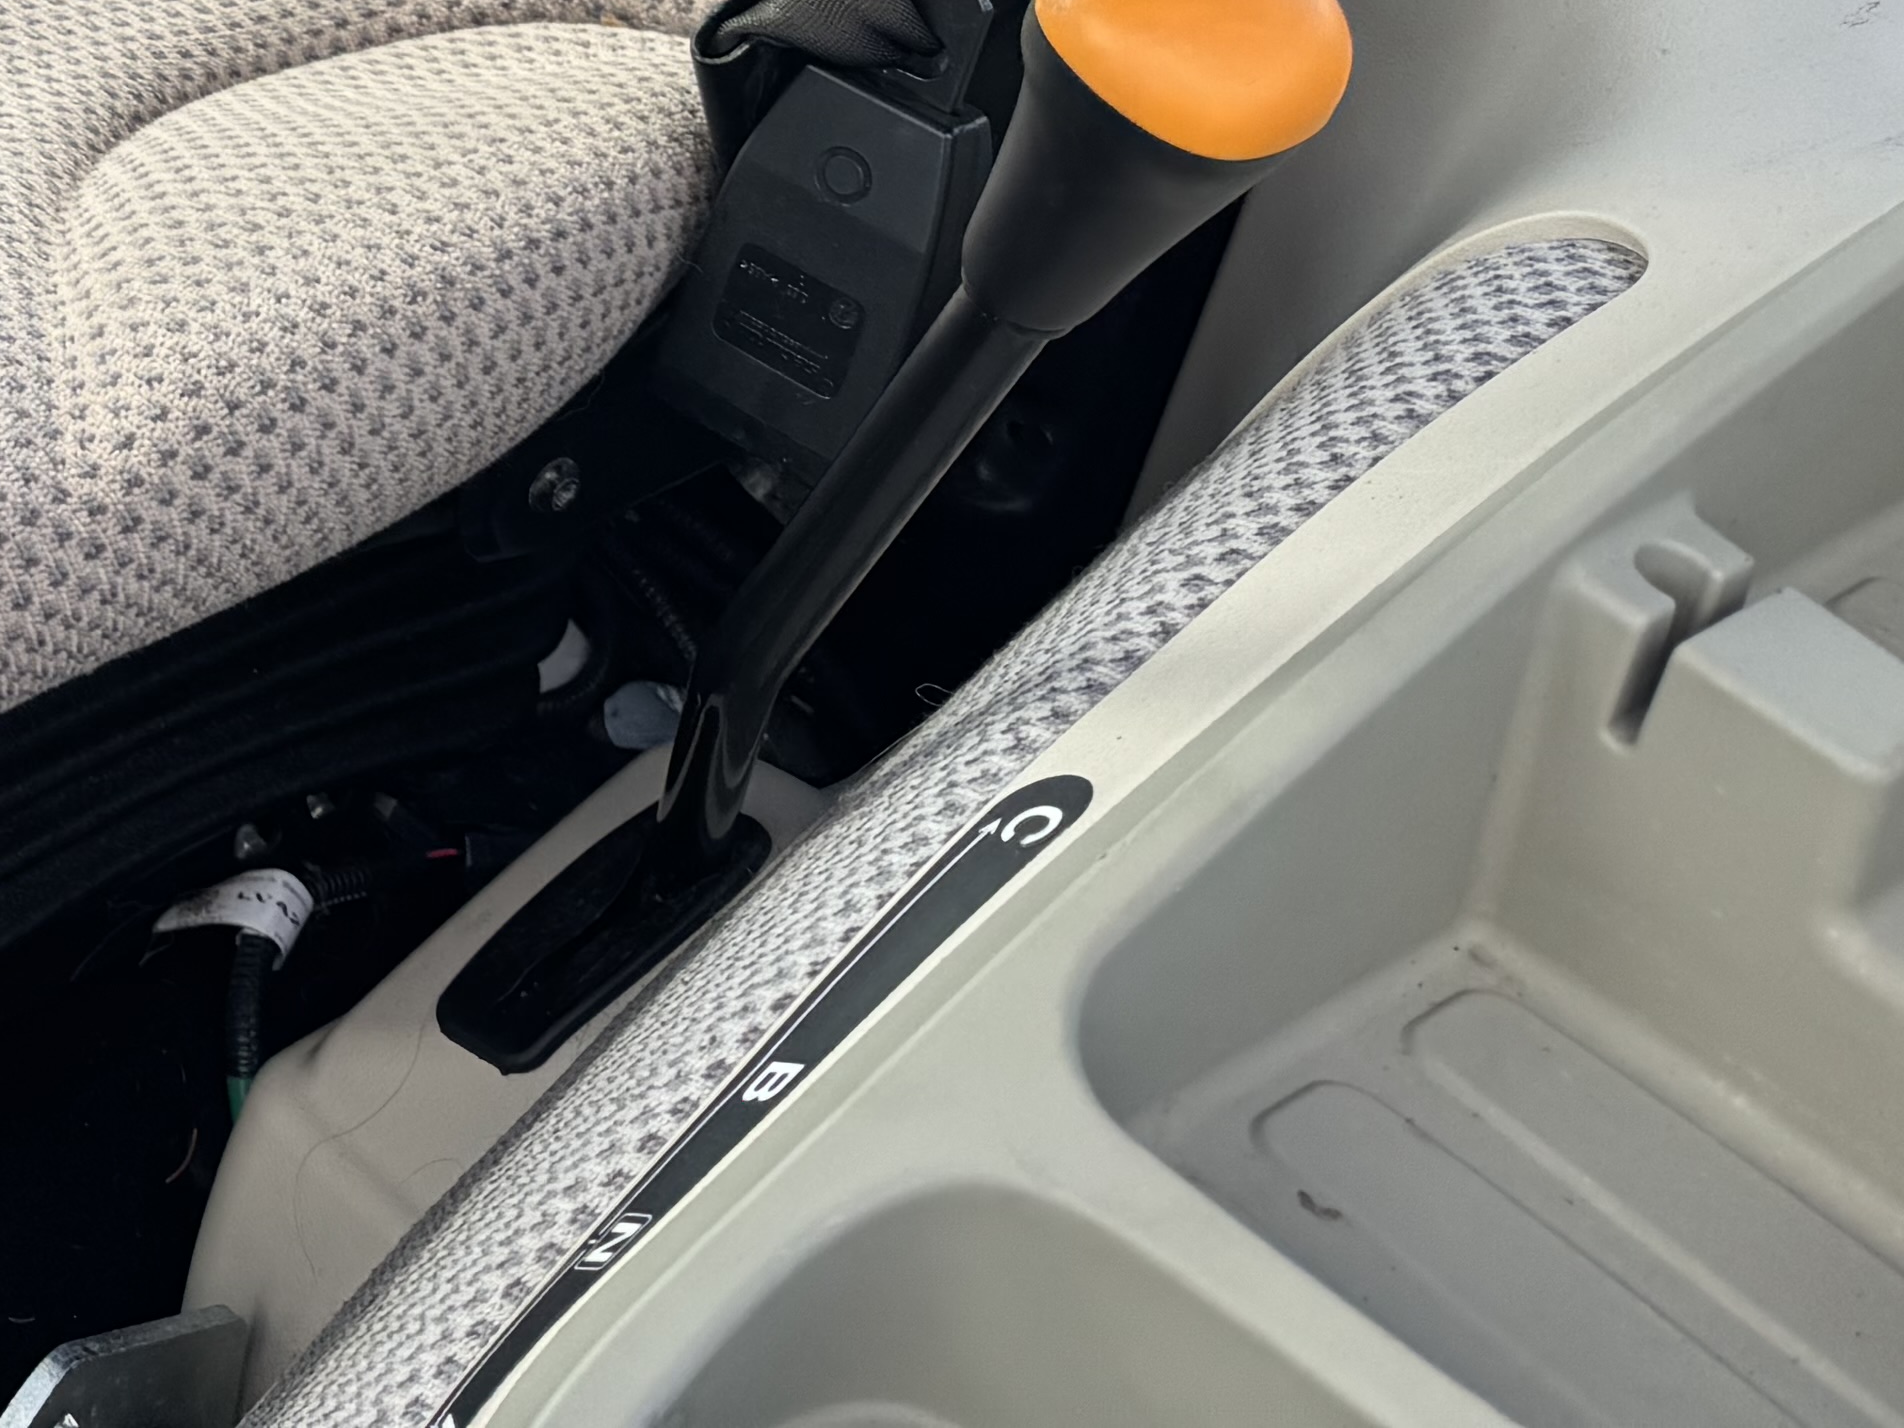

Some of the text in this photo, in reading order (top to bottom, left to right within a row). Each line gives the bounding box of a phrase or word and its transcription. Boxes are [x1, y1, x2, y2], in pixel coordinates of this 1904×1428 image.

[1000, 805, 1064, 847] C
[741, 1060, 806, 1102] B
[584, 1221, 646, 1263] N
